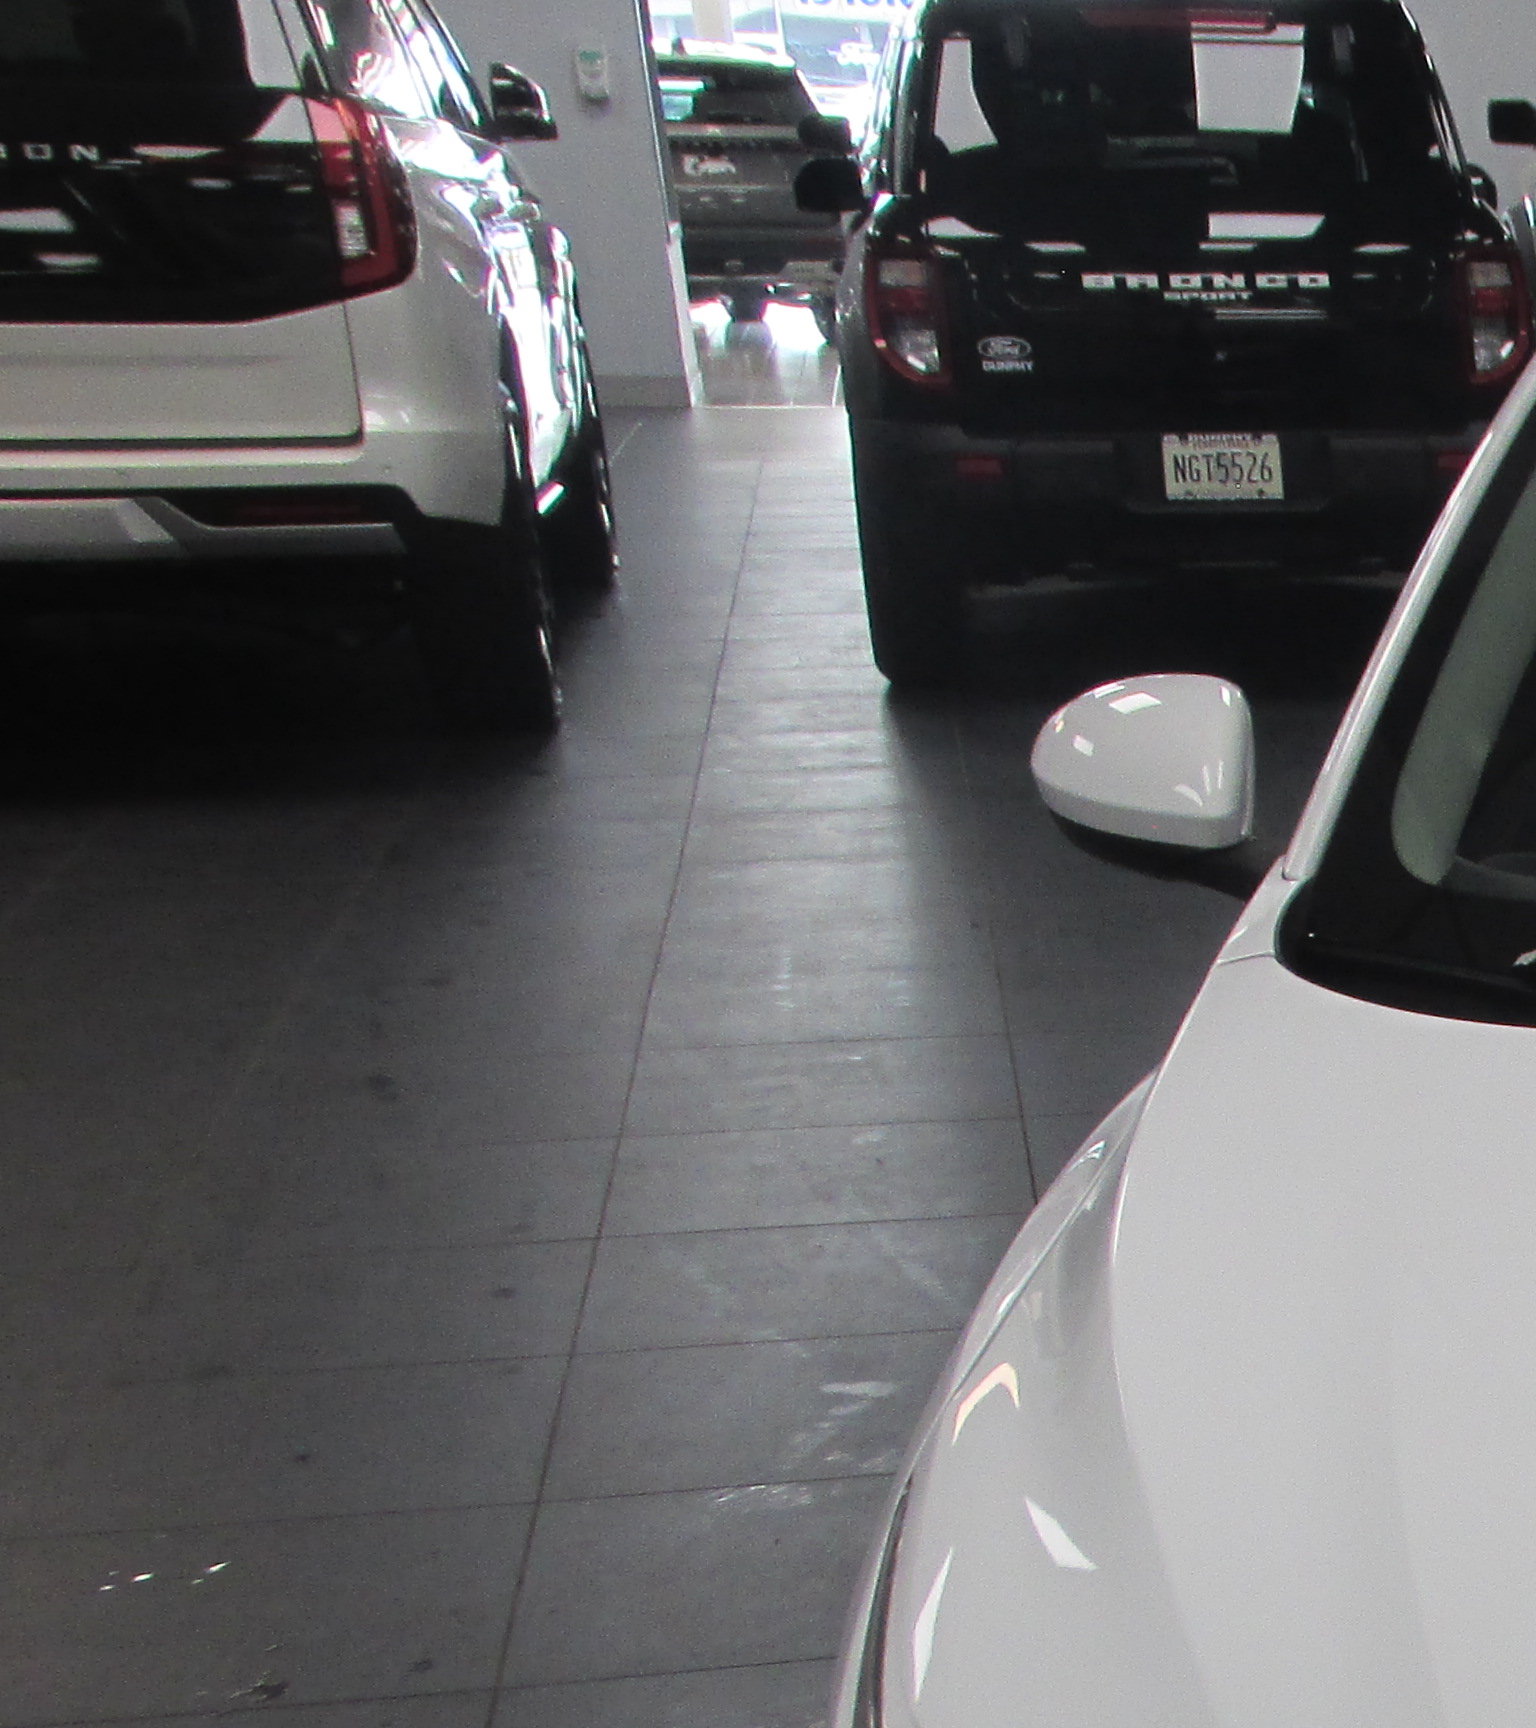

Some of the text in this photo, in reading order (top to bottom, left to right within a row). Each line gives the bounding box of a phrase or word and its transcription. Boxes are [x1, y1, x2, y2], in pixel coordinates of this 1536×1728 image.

[1081, 273, 1331, 289] BRONCO
[1163, 290, 1253, 301] SPORT
[1172, 451, 1273, 483] NGT5526
